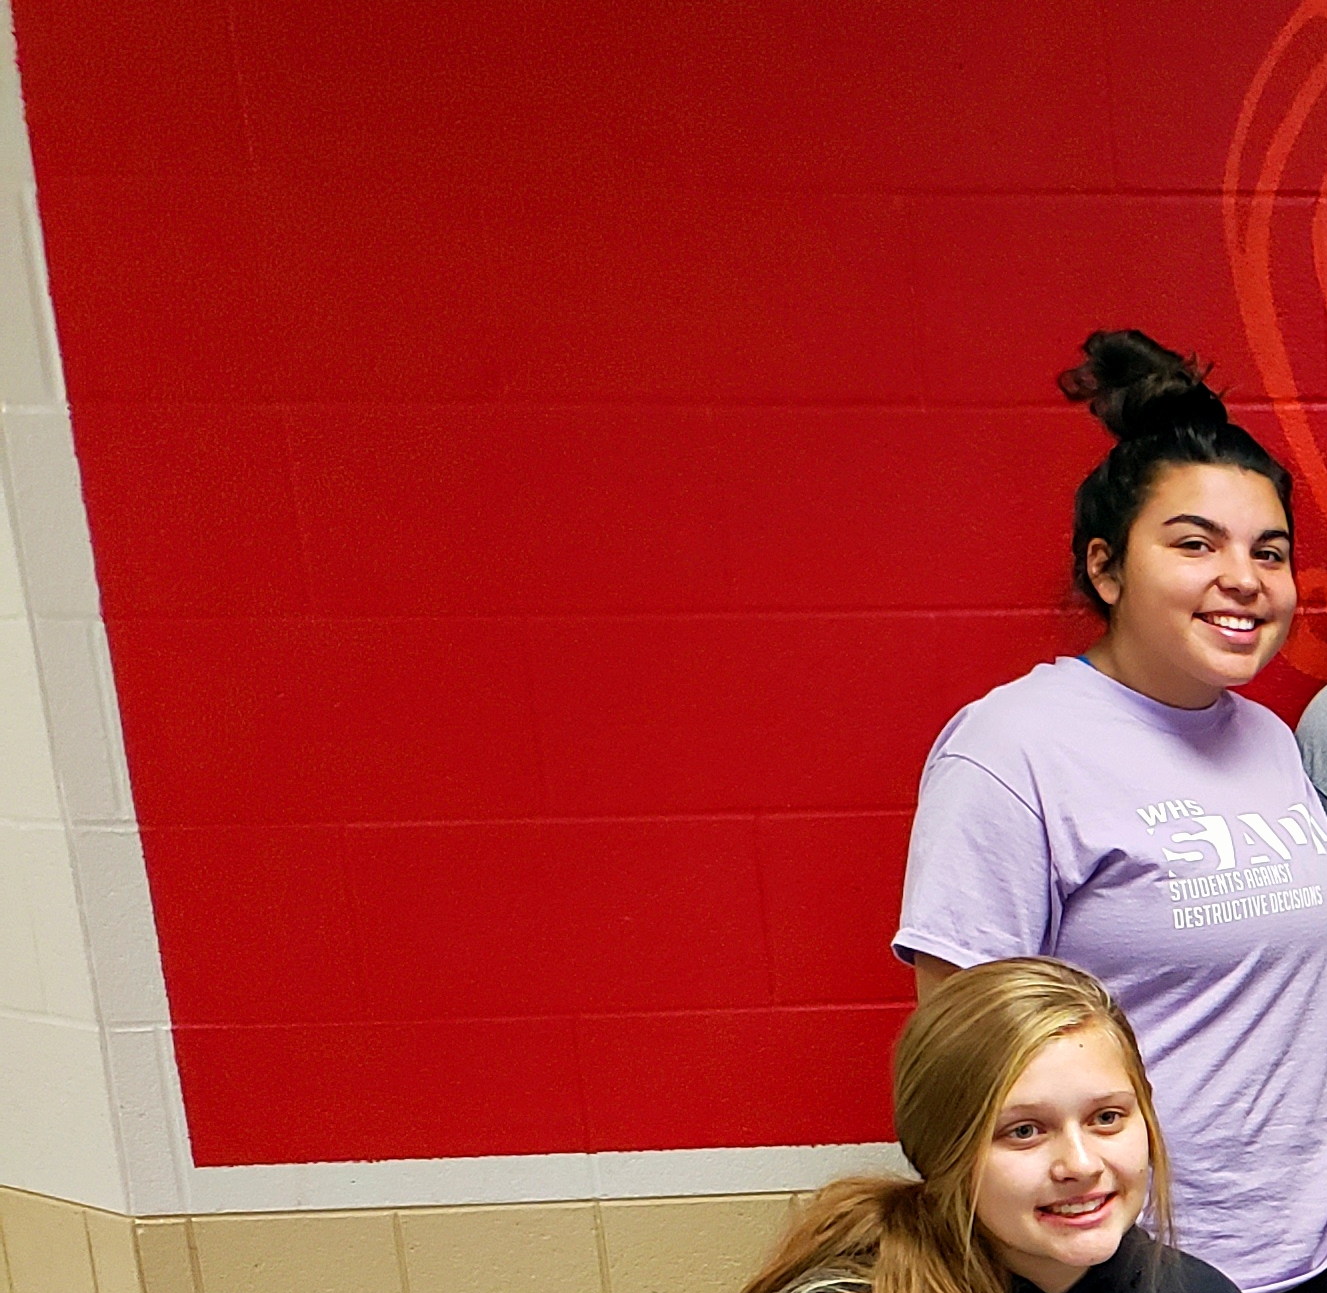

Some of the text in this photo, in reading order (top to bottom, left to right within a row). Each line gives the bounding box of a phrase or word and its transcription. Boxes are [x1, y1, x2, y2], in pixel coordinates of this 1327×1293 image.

[1136, 799, 1205, 829] WHS
[1169, 863, 1293, 902] STUDENTS AGAINST
[1172, 885, 1323, 930] DESTRUCTIVE DECISIONS
